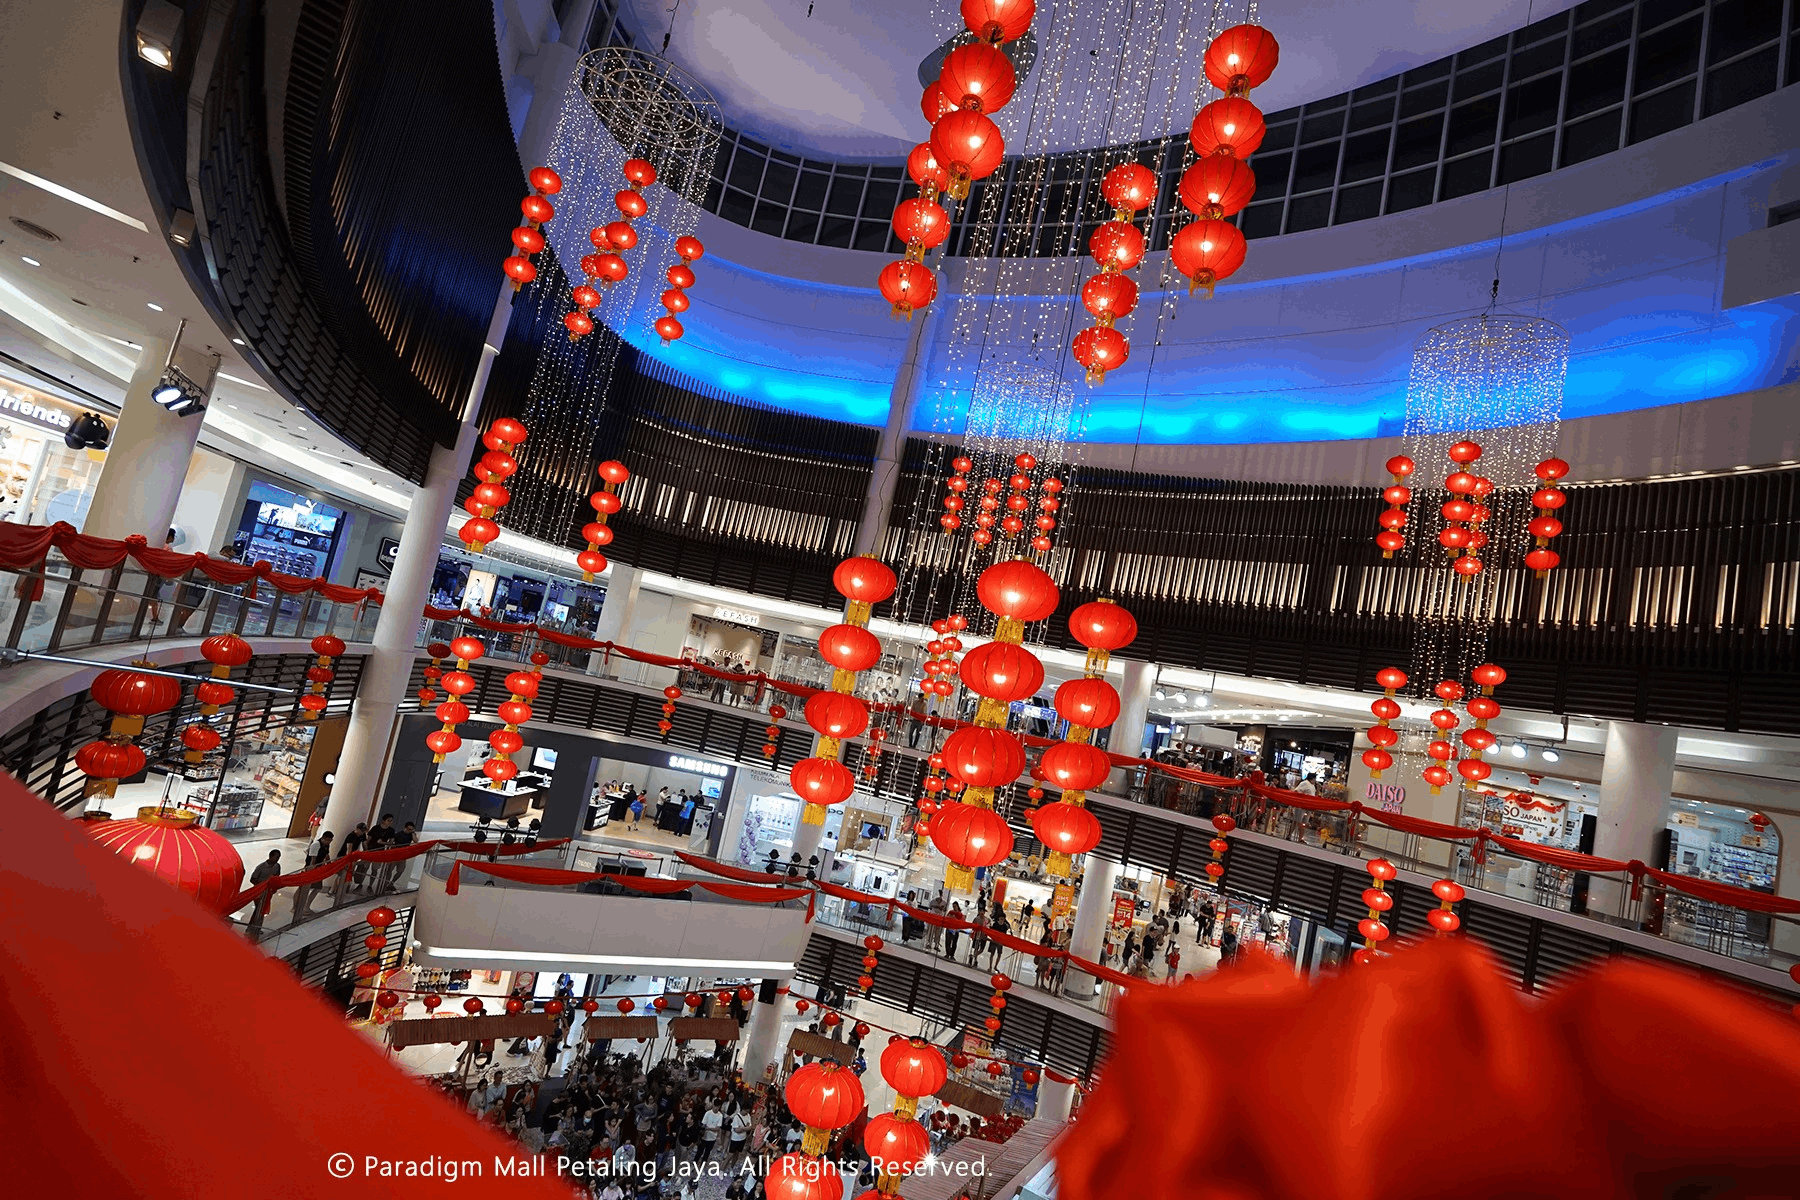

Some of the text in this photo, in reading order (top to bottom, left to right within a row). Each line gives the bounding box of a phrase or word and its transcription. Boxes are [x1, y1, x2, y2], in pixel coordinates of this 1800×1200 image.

[669, 755, 729, 777] SAMSUNG
[1366, 782, 1405, 804] DAISO
[1520, 813, 1542, 822] JAPAN
